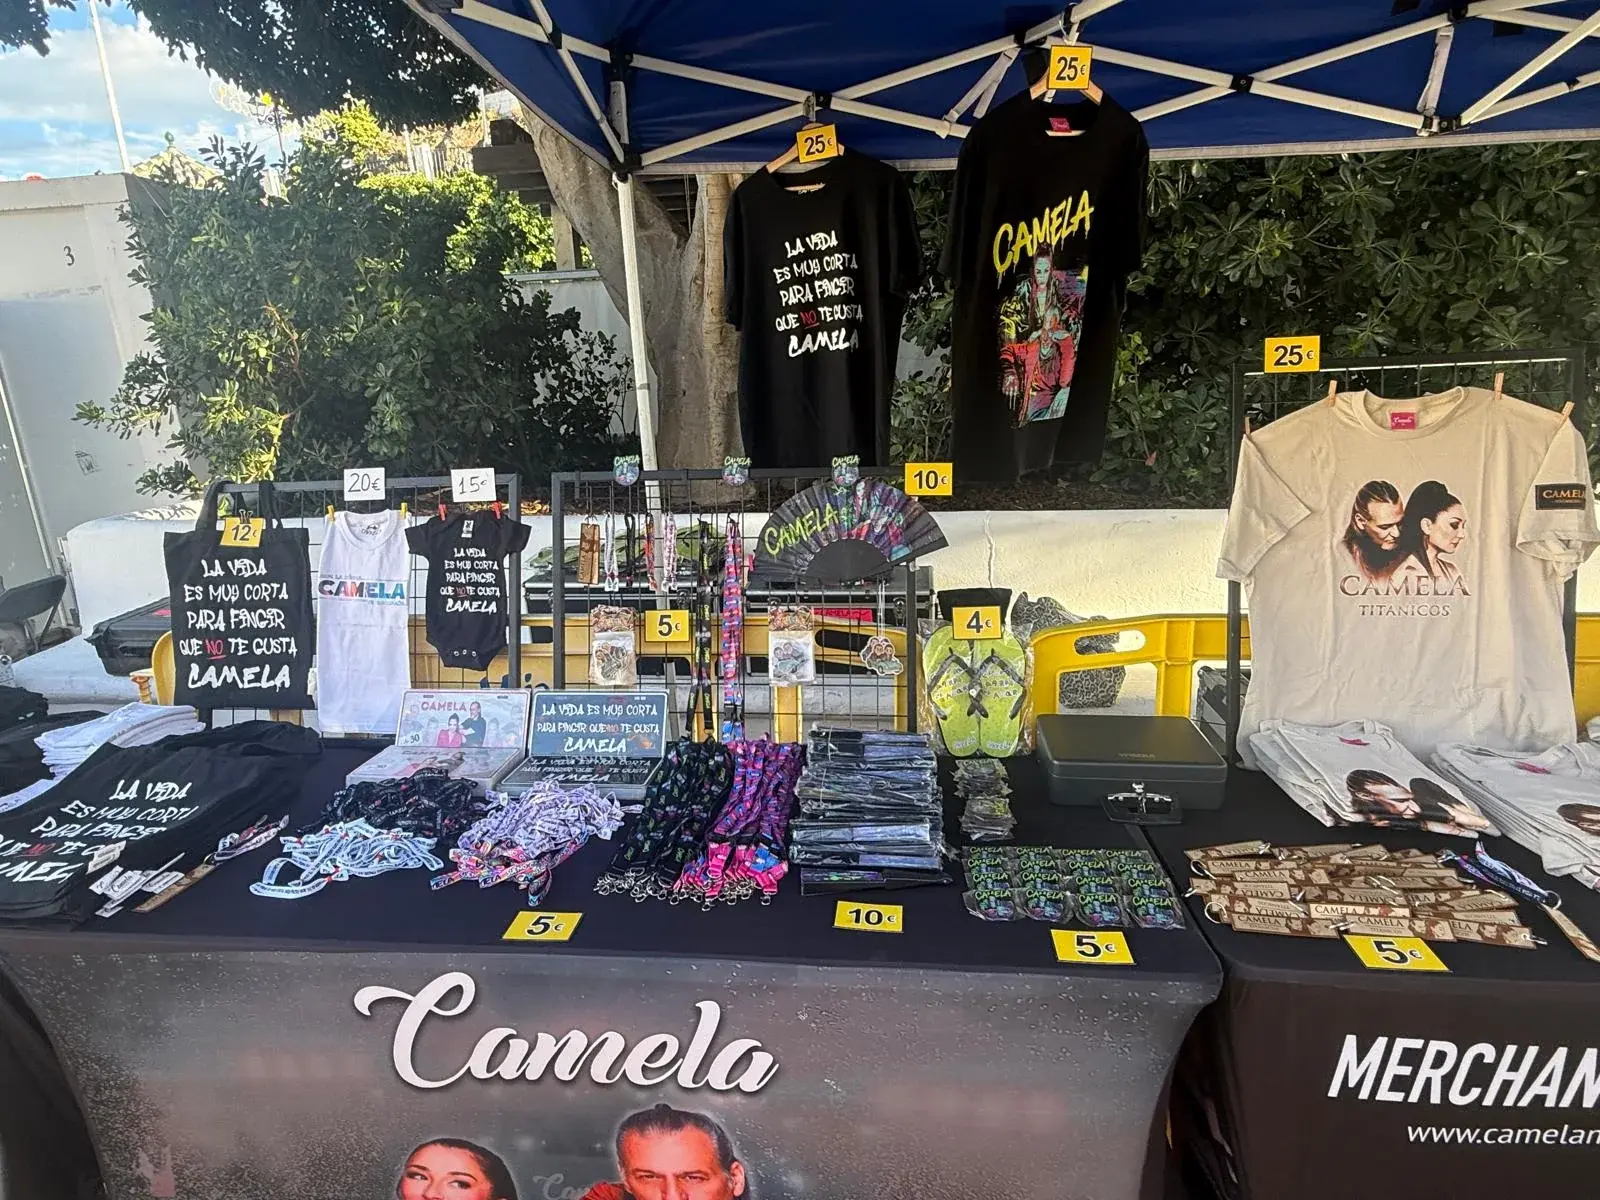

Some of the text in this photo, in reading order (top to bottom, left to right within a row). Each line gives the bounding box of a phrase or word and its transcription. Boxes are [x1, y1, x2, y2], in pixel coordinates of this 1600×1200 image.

[784, 230, 838, 258] LA VIDA
[993, 190, 1095, 278] CAMELA
[63, 246, 75, 267] 3
[773, 253, 859, 284] ES MUY CORTA
[780, 283, 814, 306] PARA
[775, 313, 800, 332] QUE
[800, 310, 818, 327] NO
[788, 327, 860, 357] CAMELA
[348, 472, 381, 493] 20€
[765, 503, 840, 557] CAMELA
[454, 547, 465, 557] LA
[201, 558, 268, 578] LA VIDA
[445, 560, 455, 570] ES
[473, 560, 499, 570] CORTA
[445, 572, 466, 584] PARA
[1339, 574, 1472, 596] CAMELA
[183, 582, 289, 604] ES MUY CORTA
[318, 580, 405, 599] CAMELA
[440, 586, 455, 596] QUE
[446, 598, 497, 615] CAMELA
[1358, 604, 1451, 617] TITANICOS
[186, 608, 286, 632] PARA FINGIR
[658, 614, 681, 637] 5€
[966, 610, 992, 634] 4€
[180, 637, 298, 658] QUE NO TE GUSTA
[187, 663, 291, 691] CAMELA
[420, 702, 467, 712] CAMELA
[542, 703, 556, 716] LA
[559, 703, 585, 717] VIDA
[587, 703, 600, 716] ES
[626, 703, 658, 717] CORTA
[410, 733, 420, 744] 30
[537, 722, 556, 734] PARA
[589, 723, 606, 733] QUE
[620, 723, 632, 733] TE
[633, 723, 660, 734] GUSTA
[564, 737, 627, 753] CAMELA
[109, 780, 192, 802] LA VIDA
[60, 800, 96, 818] ES
[1238, 915, 1283, 925] CAMELA
[1315, 905, 1357, 915] CAMELA
[1358, 916, 1404, 927] CAMELA
[353, 971, 780, 1093] Camela
